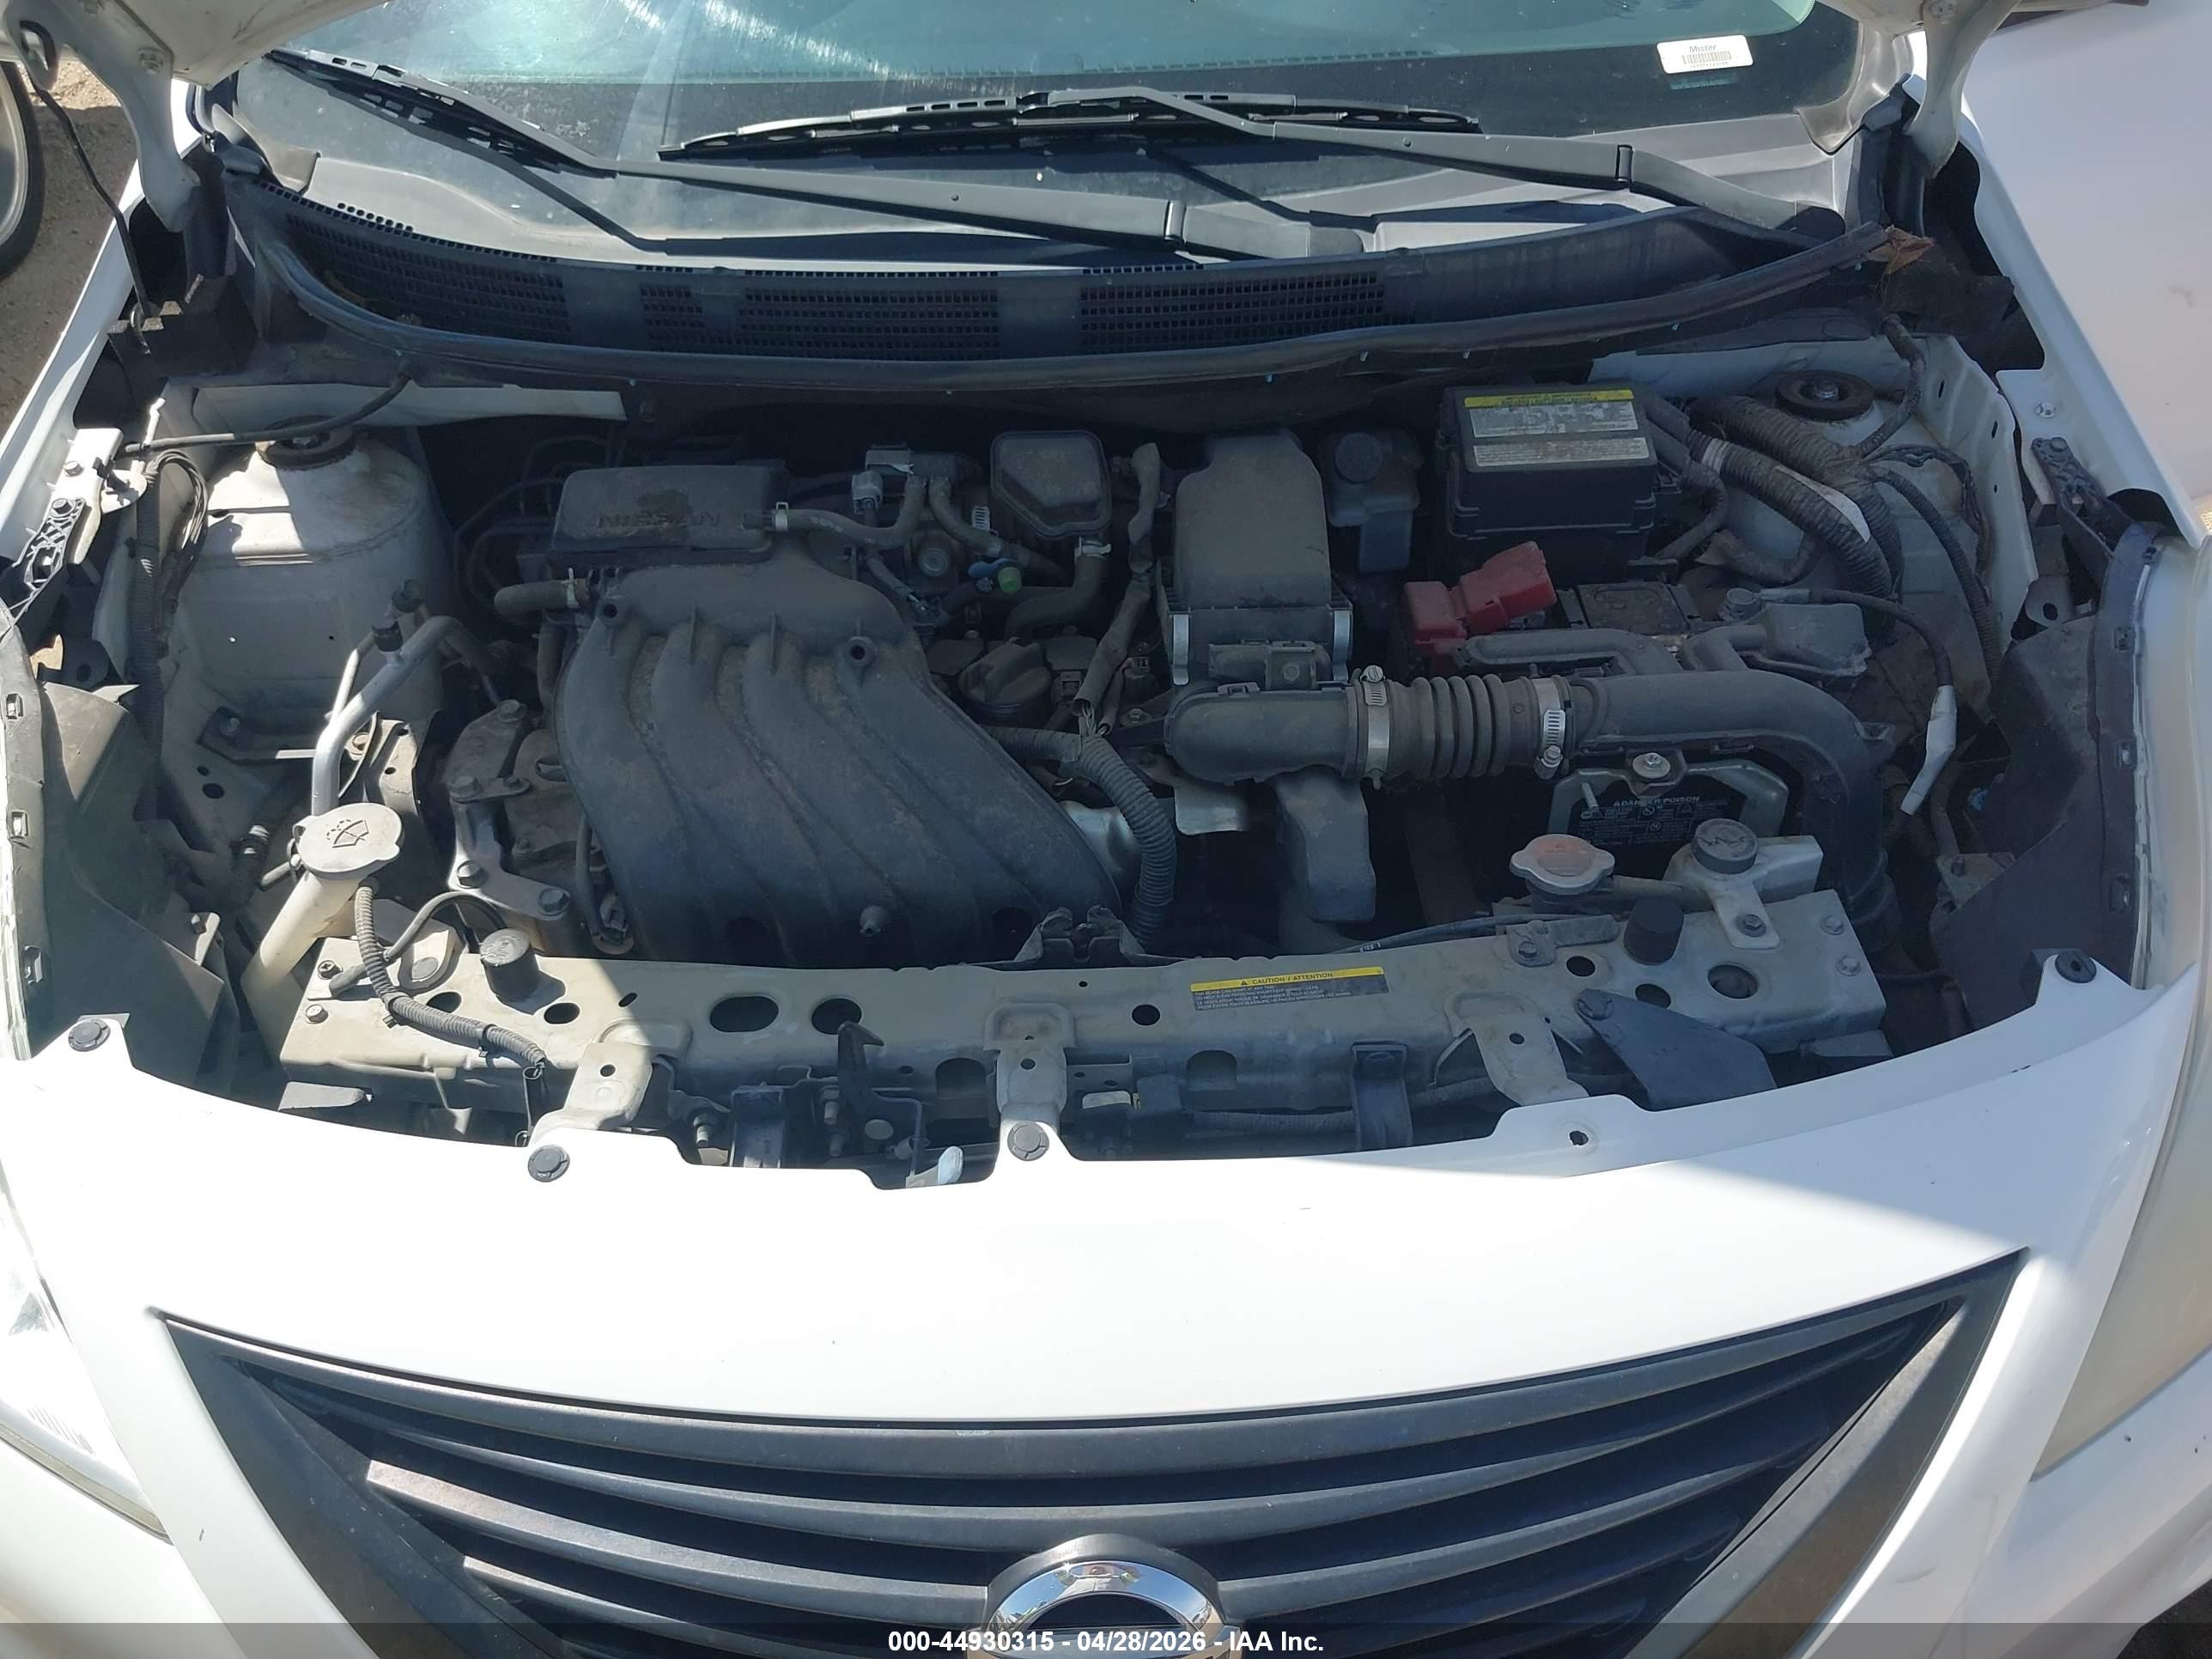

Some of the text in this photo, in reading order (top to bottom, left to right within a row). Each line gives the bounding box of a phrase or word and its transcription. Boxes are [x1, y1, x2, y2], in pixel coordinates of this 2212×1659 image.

[1689, 44, 1717, 53] Mister
[598, 511, 720, 528] NISSAN
[1663, 795, 1701, 805] POISON
[1252, 976, 1285, 985] CAUTION
[1292, 972, 1334, 981] ATTENTION
